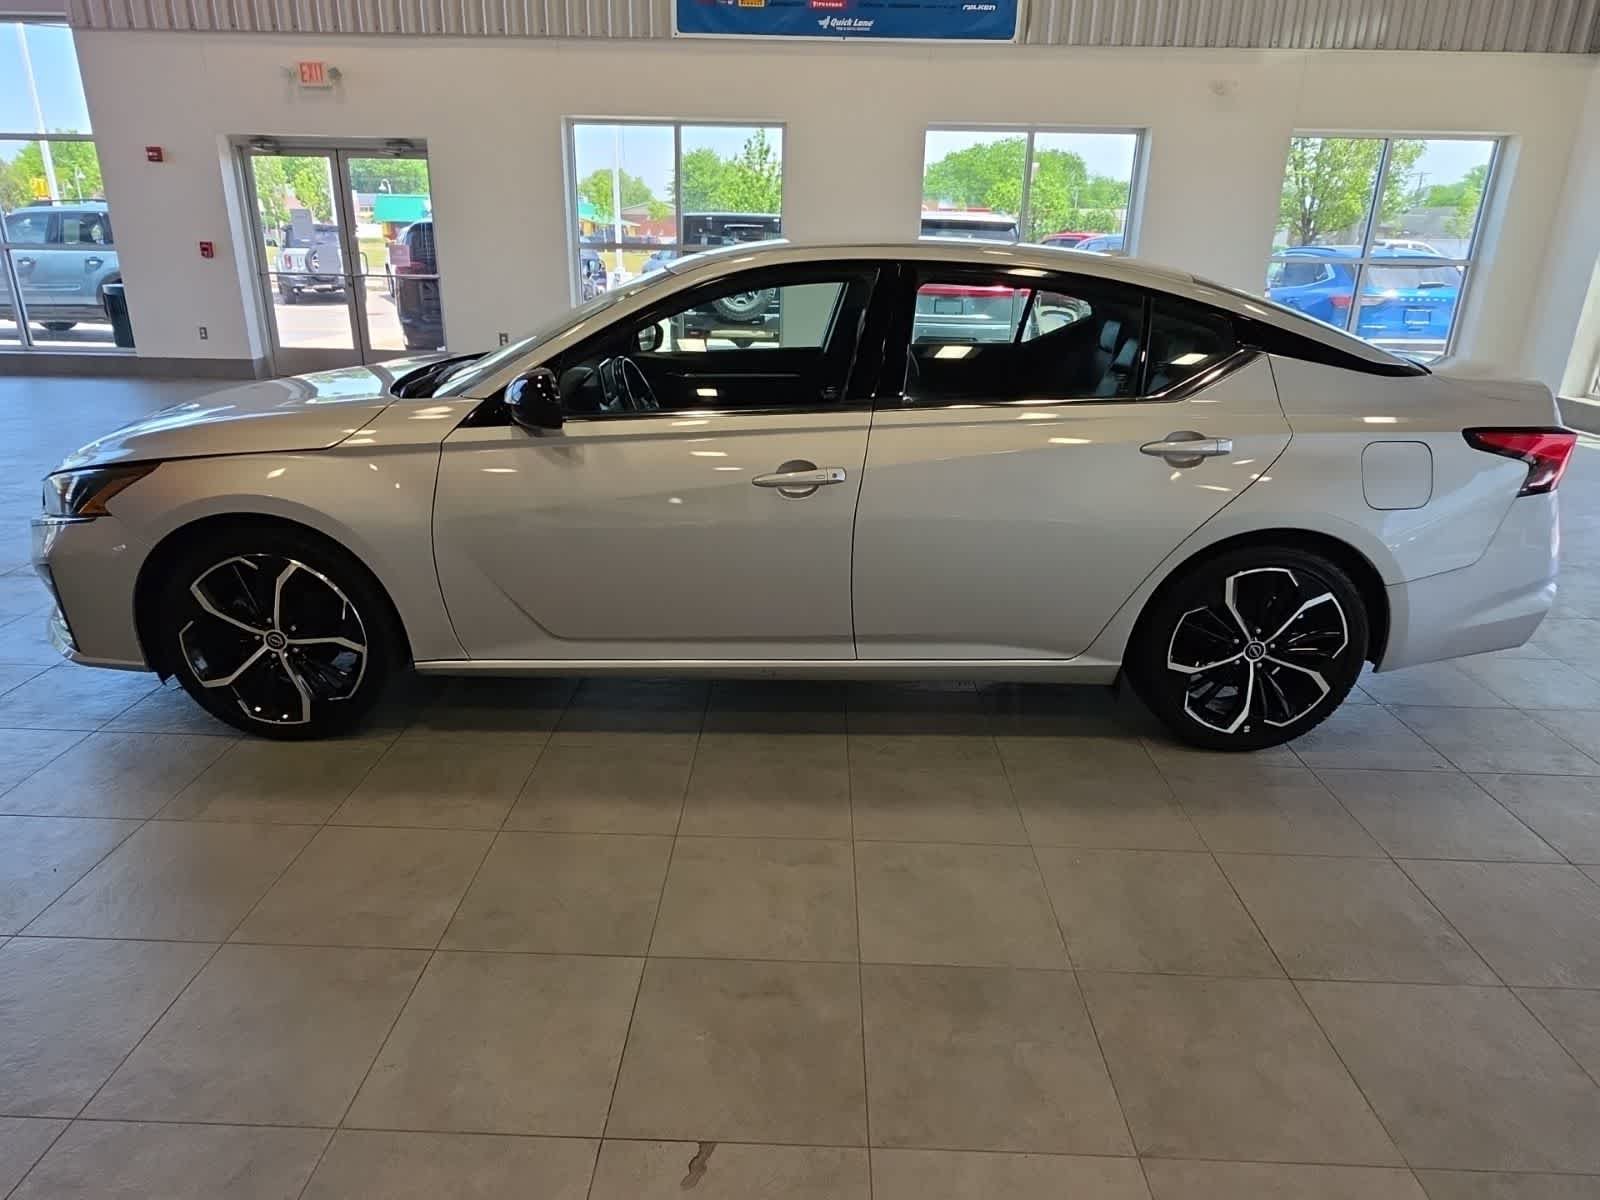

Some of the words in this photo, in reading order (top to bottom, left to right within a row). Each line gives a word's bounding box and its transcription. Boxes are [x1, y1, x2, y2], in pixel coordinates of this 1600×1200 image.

[830, 17, 852, 27] Quick
[853, 18, 874, 27] Lane
[299, 62, 324, 82] EXIT
